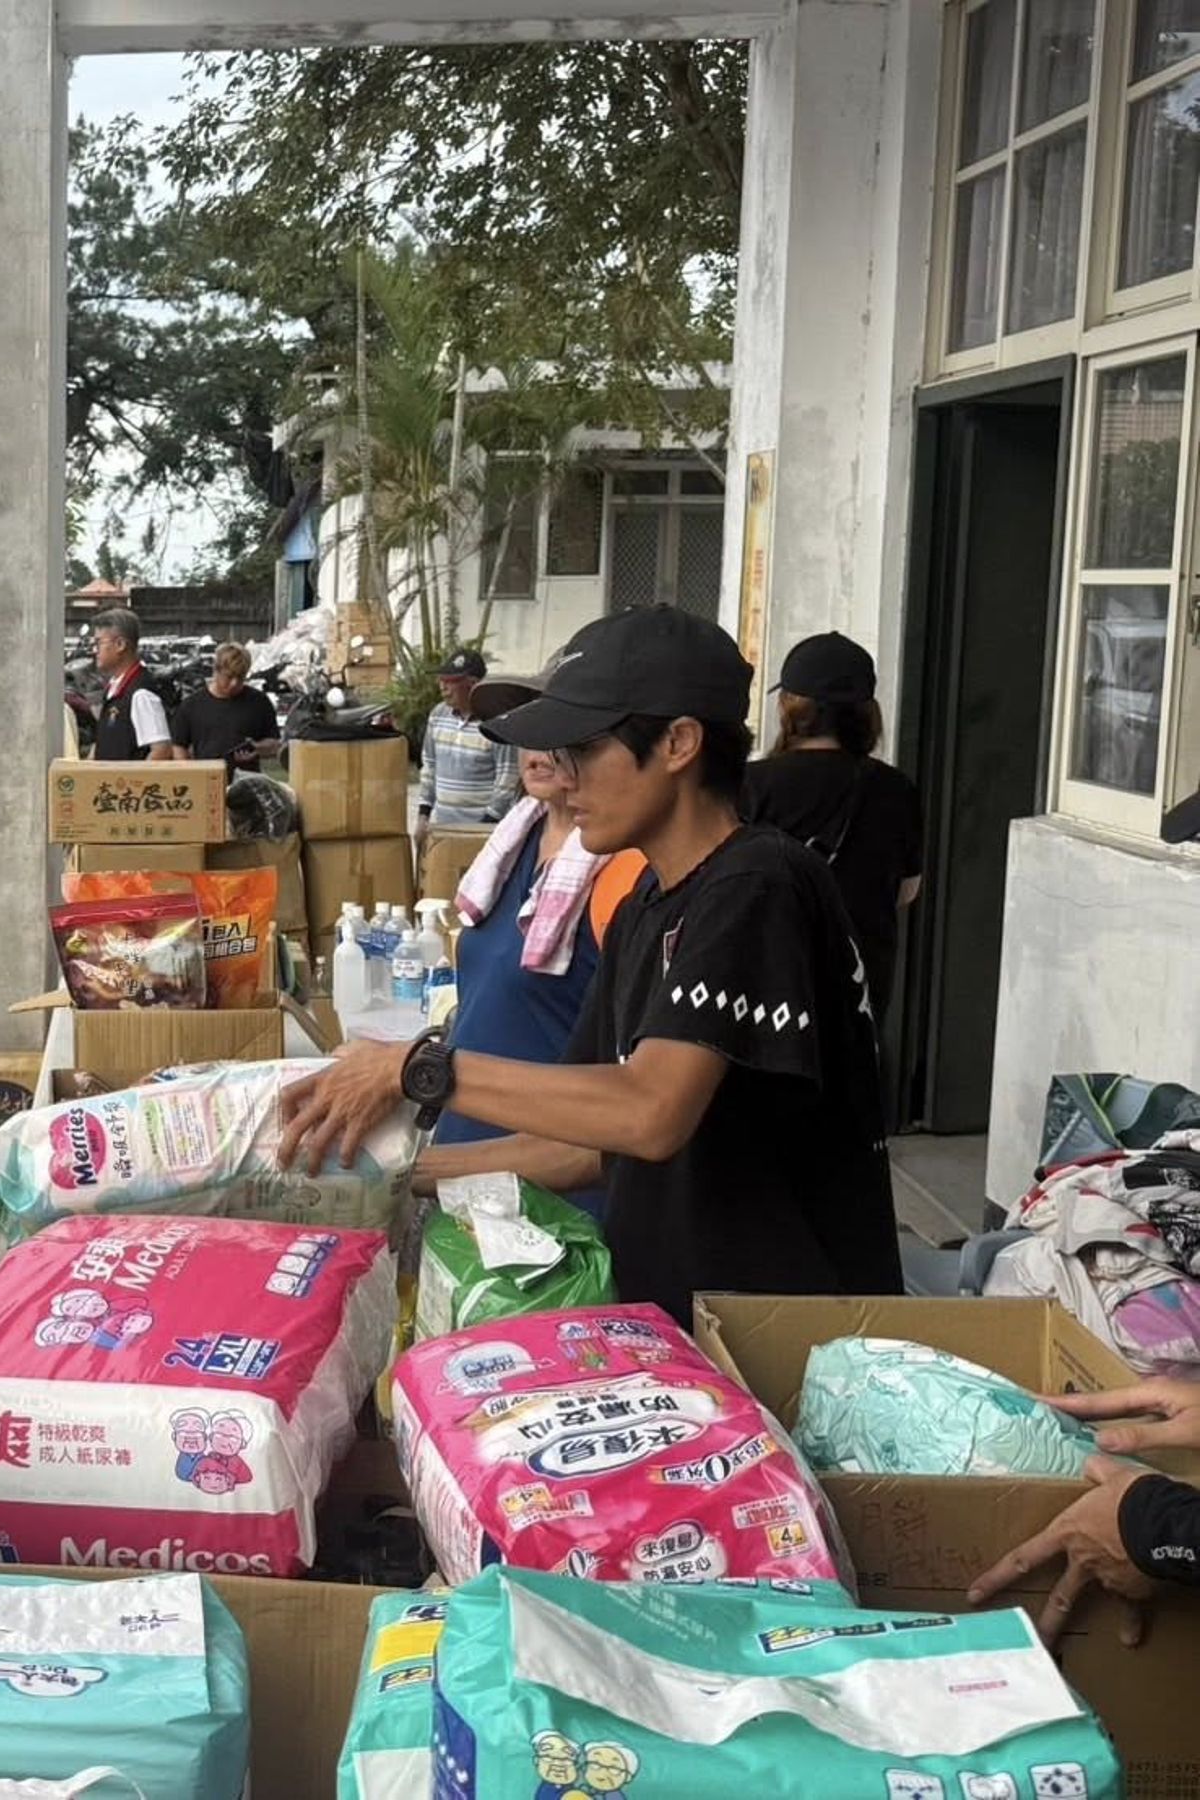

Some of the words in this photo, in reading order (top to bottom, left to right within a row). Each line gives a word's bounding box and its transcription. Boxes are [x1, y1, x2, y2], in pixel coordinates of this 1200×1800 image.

[70, 1107, 98, 1186] Merries
[70, 1236, 128, 1284] 安爽
[163, 1337, 211, 1368] 24
[38, 1422, 107, 1443] 特級乾爽
[60, 1536, 272, 1574] Medicos
